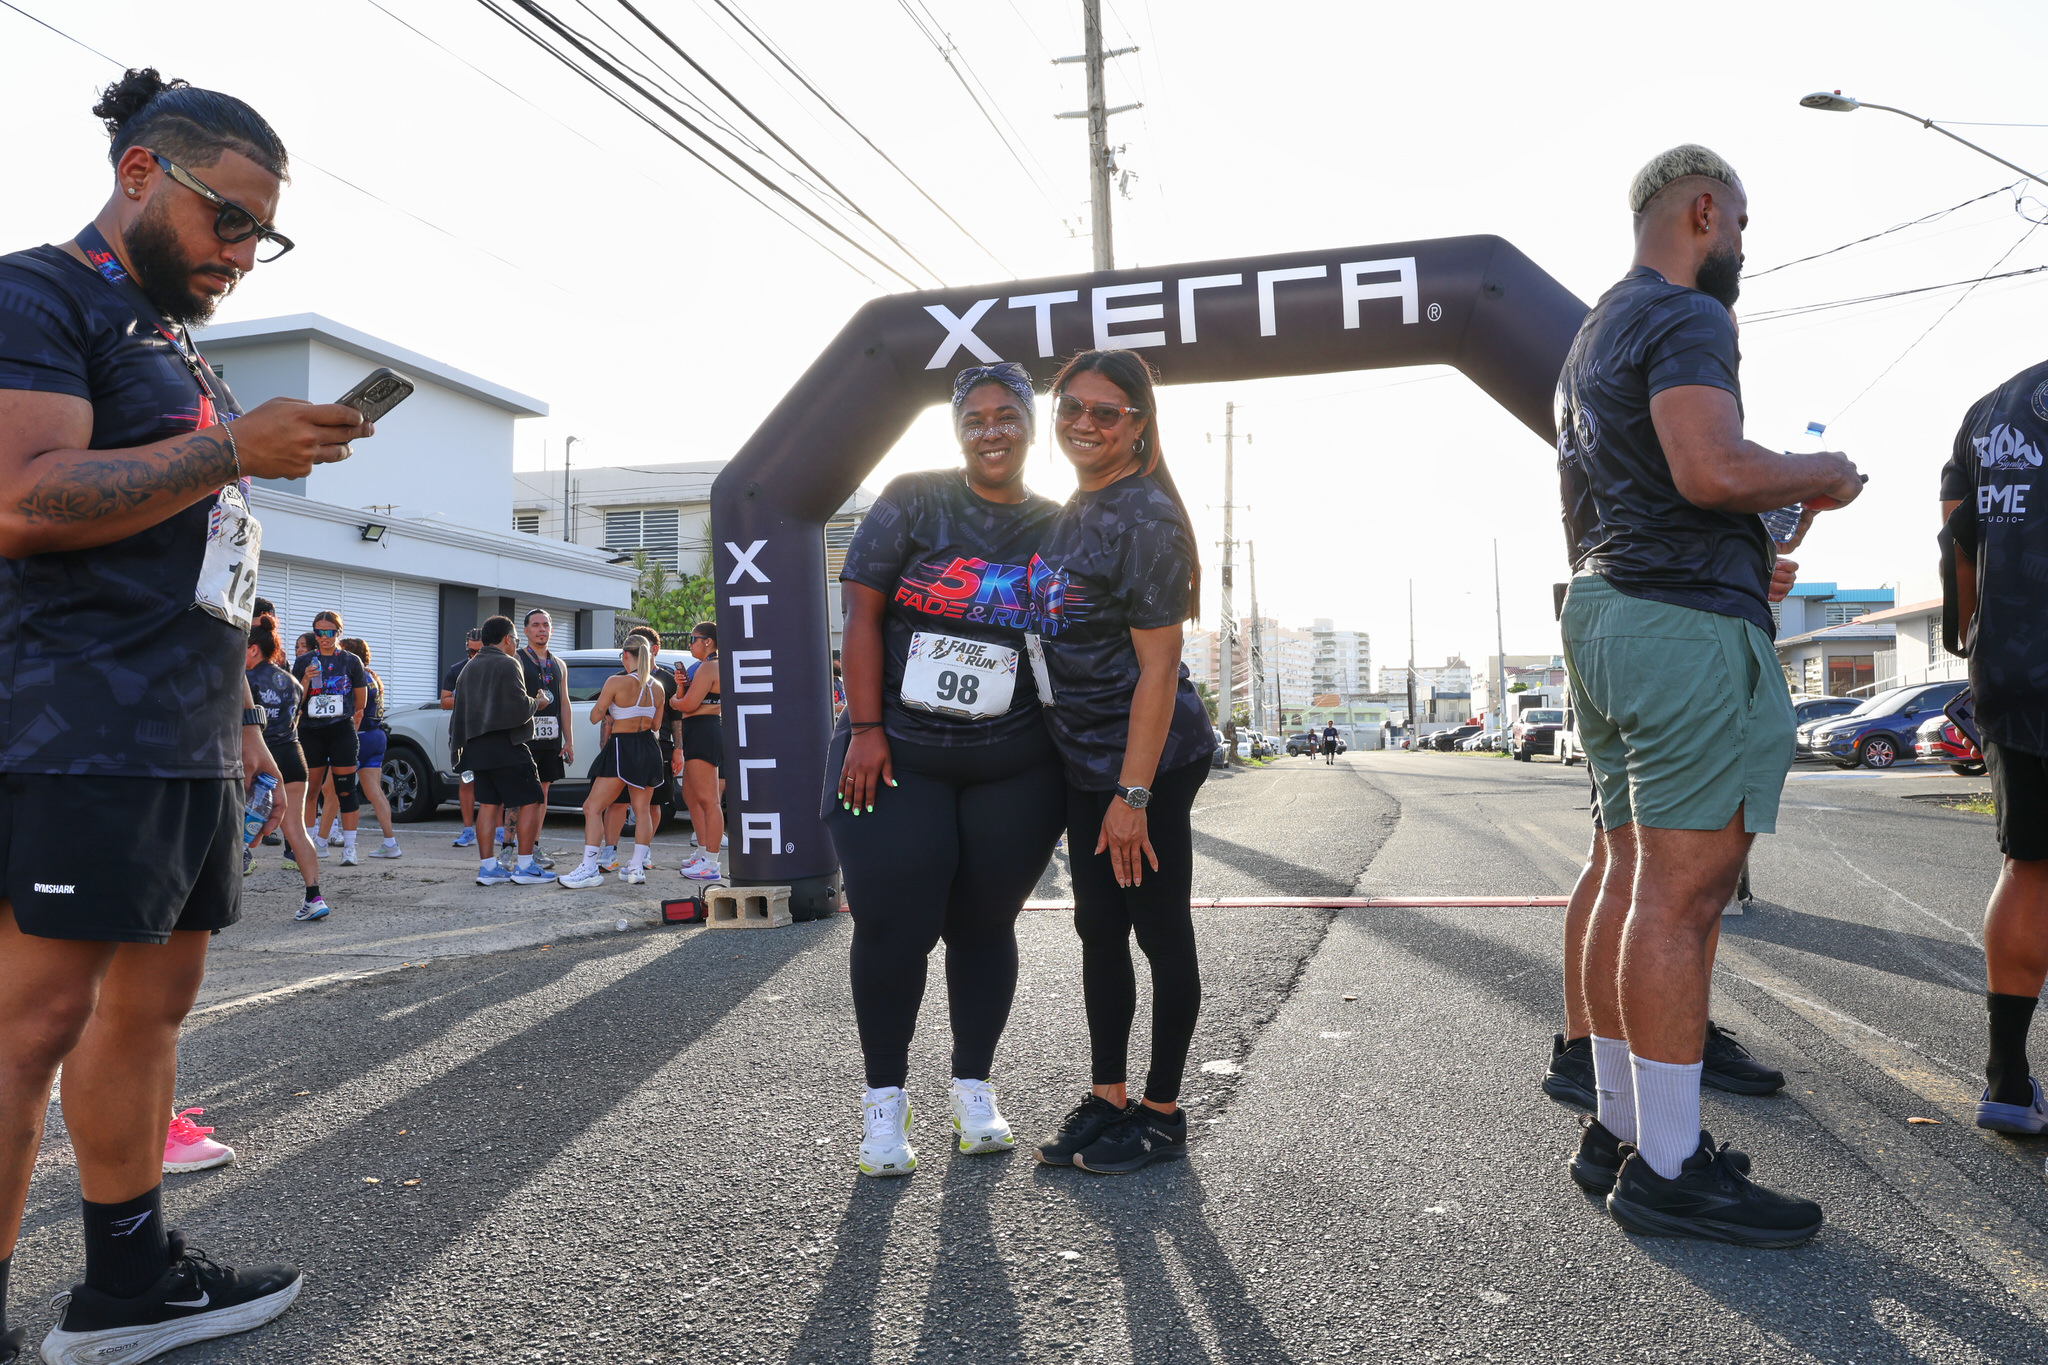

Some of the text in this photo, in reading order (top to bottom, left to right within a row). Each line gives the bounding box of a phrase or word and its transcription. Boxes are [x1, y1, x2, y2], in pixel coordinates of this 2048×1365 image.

[928, 557, 1027, 609] 5K
[894, 586, 969, 619] FADE
[966, 605, 988, 623] &
[949, 640, 987, 656] FADE
[955, 653, 965, 664] &
[964, 655, 998, 670] RUN
[936, 670, 980, 705] 98
[315, 704, 336, 715] 219
[34, 882, 76, 894] GYMSHARK
